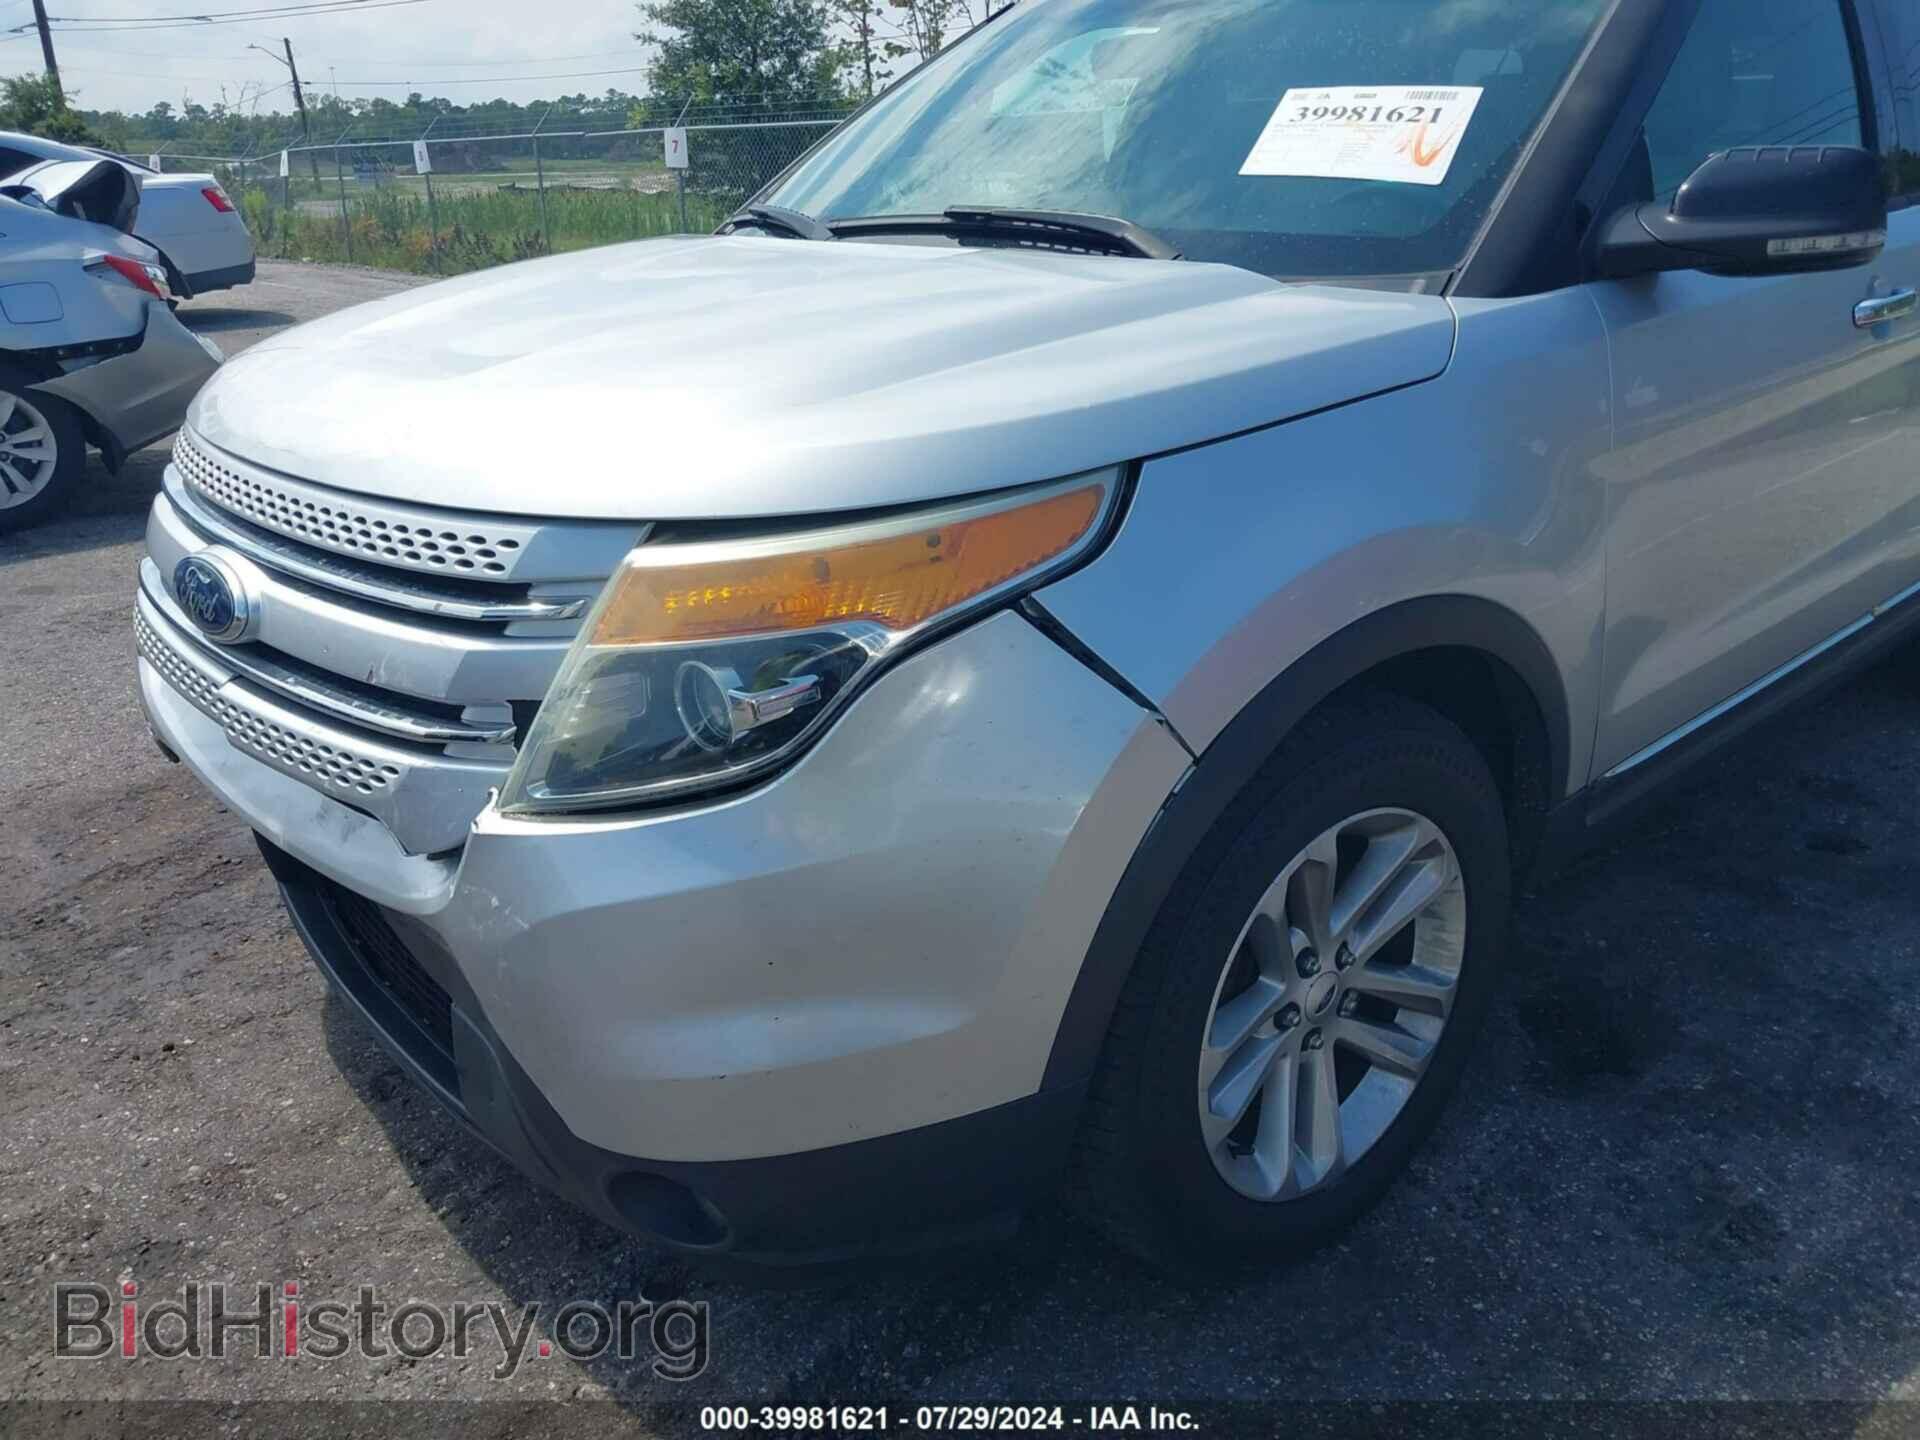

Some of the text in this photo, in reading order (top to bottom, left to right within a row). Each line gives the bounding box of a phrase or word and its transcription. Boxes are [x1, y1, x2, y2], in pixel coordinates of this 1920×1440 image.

[1289, 105, 1443, 123] 39981621
[671, 139, 679, 154] 7
[180, 566, 219, 621] Ford
